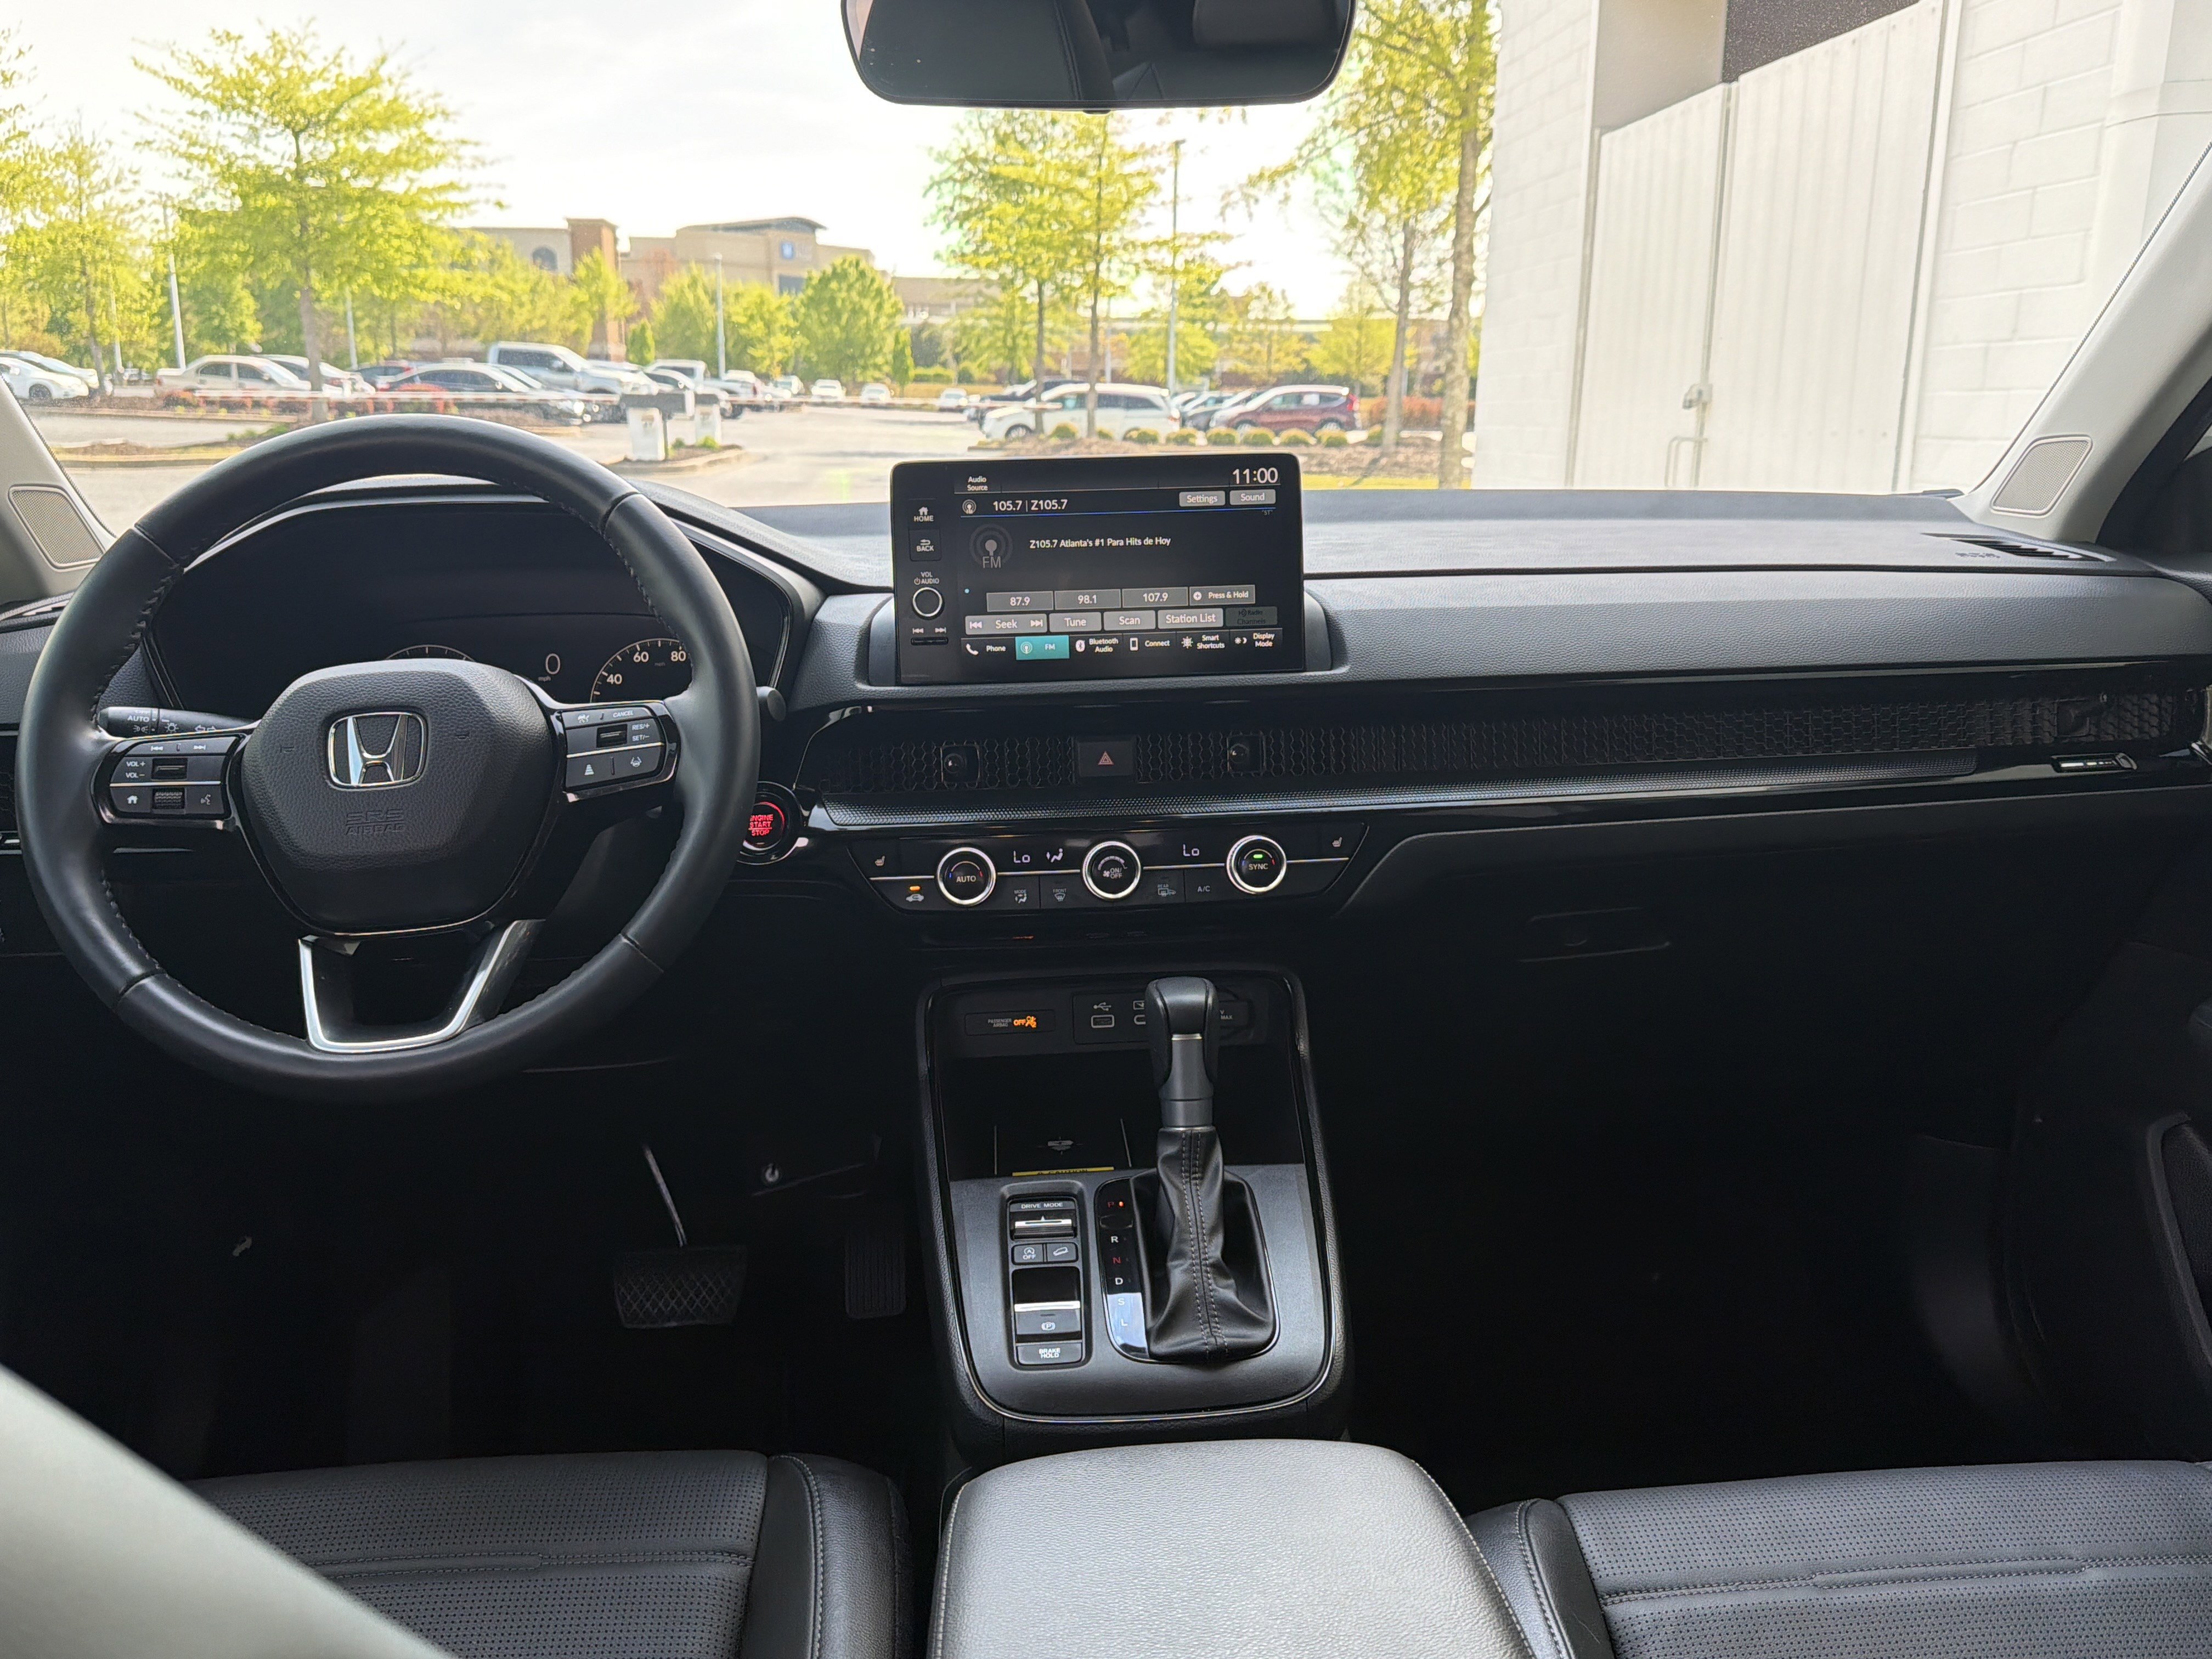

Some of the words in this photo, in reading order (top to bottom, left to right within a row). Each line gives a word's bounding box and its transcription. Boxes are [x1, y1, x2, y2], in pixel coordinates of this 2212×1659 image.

[1232, 467, 1278, 484] 11:00
[1186, 494, 1218, 504] Settings
[1240, 492, 1265, 501] Sound
[992, 500, 1023, 511] 105.7
[1030, 499, 1068, 511] Z105.7
[1029, 539, 1058, 549] Z105.7
[1059, 538, 1093, 548] Atlanta's
[1094, 538, 1104, 547] #1
[1107, 538, 1124, 546] Para
[1126, 537, 1142, 546] Hits
[1143, 537, 1153, 545] de
[1155, 536, 1171, 546] Hoy
[981, 556, 1001, 568] FM
[1077, 595, 1097, 604] 98.1
[1143, 592, 1169, 602] 107.9
[1233, 590, 1249, 599] Hold
[1009, 596, 1030, 606] 87.9
[995, 619, 1018, 629] Seek
[1064, 617, 1087, 627] Tune
[1119, 617, 1141, 625] Scan
[1165, 614, 1197, 624] Station
[1199, 613, 1216, 623] List
[1253, 633, 1275, 641] Display
[633, 651, 649, 663] 60
[670, 651, 686, 662] 80
[545, 653, 561, 674] 0
[606, 674, 623, 685] 40
[345, 808, 404, 822] SRS
[345, 824, 404, 834] AIRBAG
[1183, 844, 1200, 857] Lo
[1013, 850, 1030, 863] Lo
